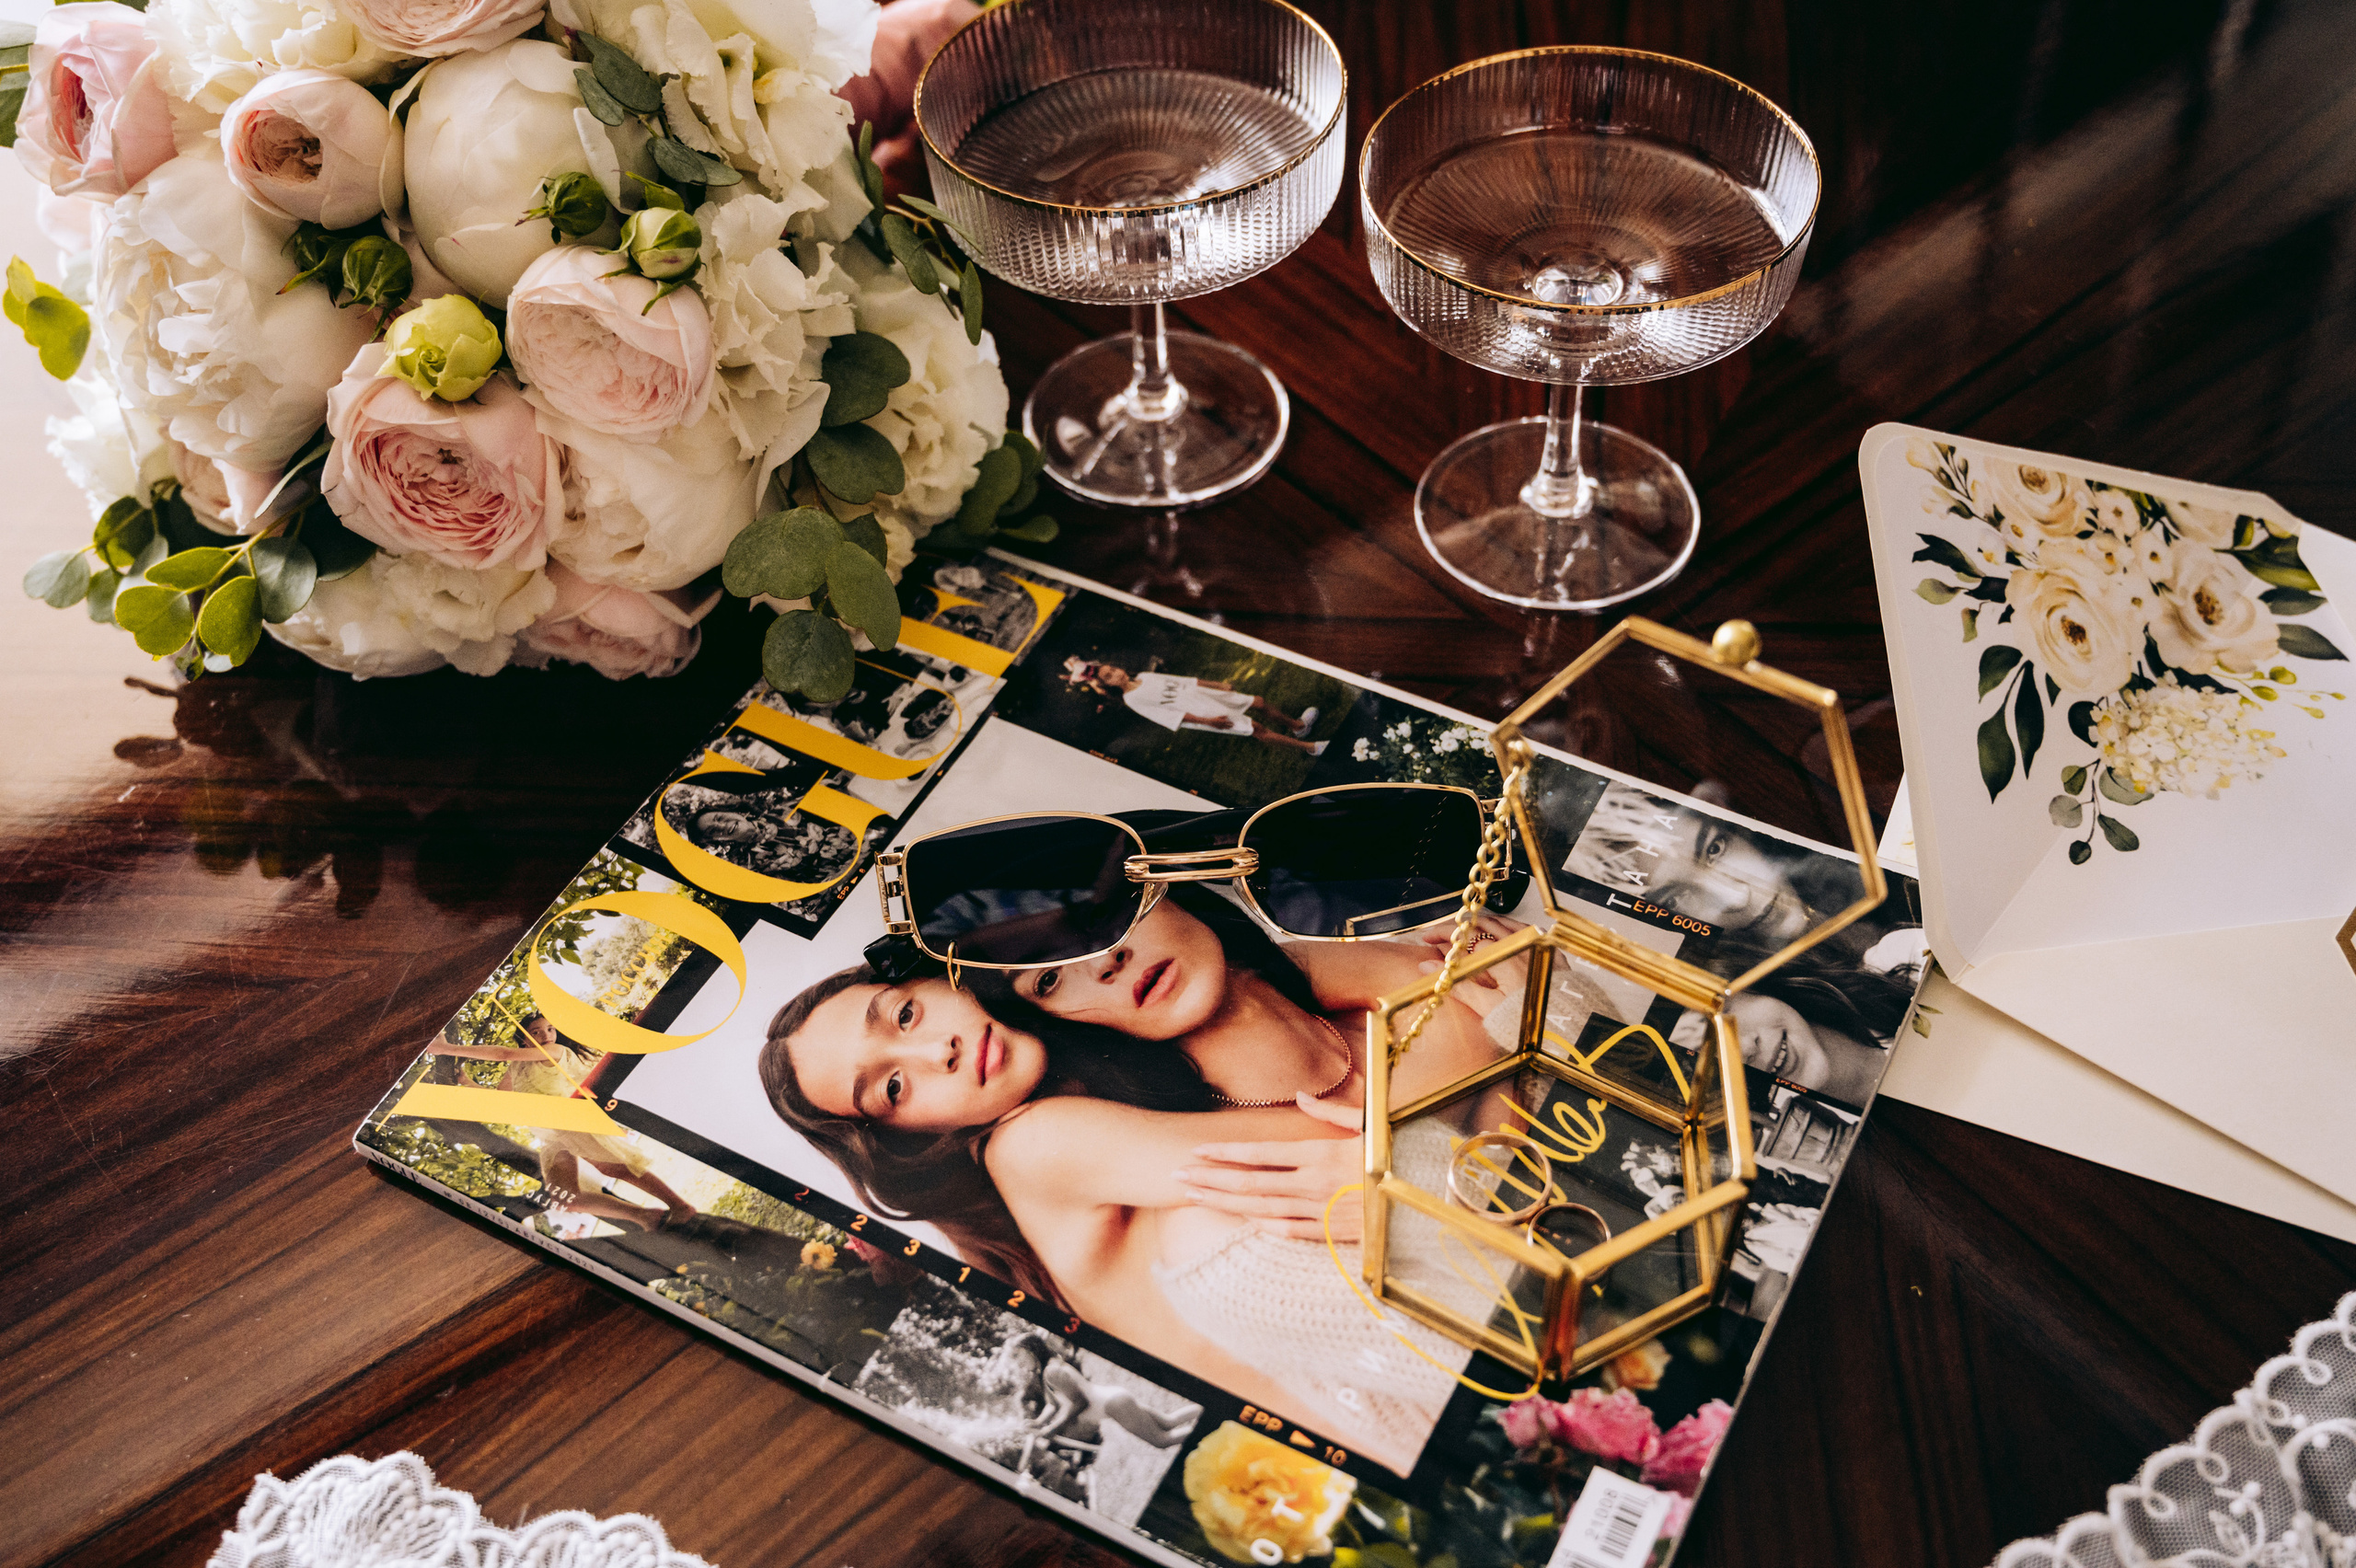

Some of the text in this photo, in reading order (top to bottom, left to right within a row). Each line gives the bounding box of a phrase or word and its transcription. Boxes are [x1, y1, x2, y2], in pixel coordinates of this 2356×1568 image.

[375, 571, 1066, 1137] VOGUE
[837, 885, 849, 900] EPP
[1633, 900, 1712, 937] EPP 6005
[604, 1099, 618, 1113] 9
[371, 1151, 422, 1184] VOGUE
[518, 1186, 568, 1214] АВГУСТ
[545, 1182, 576, 1204] 2021
[850, 1215, 868, 1231] 2
[904, 1239, 920, 1256] 3
[958, 1267, 970, 1283] 1
[1007, 1289, 1026, 1308] 2
[1064, 1316, 1080, 1334] 3
[1239, 1404, 1347, 1467] EPP 10
